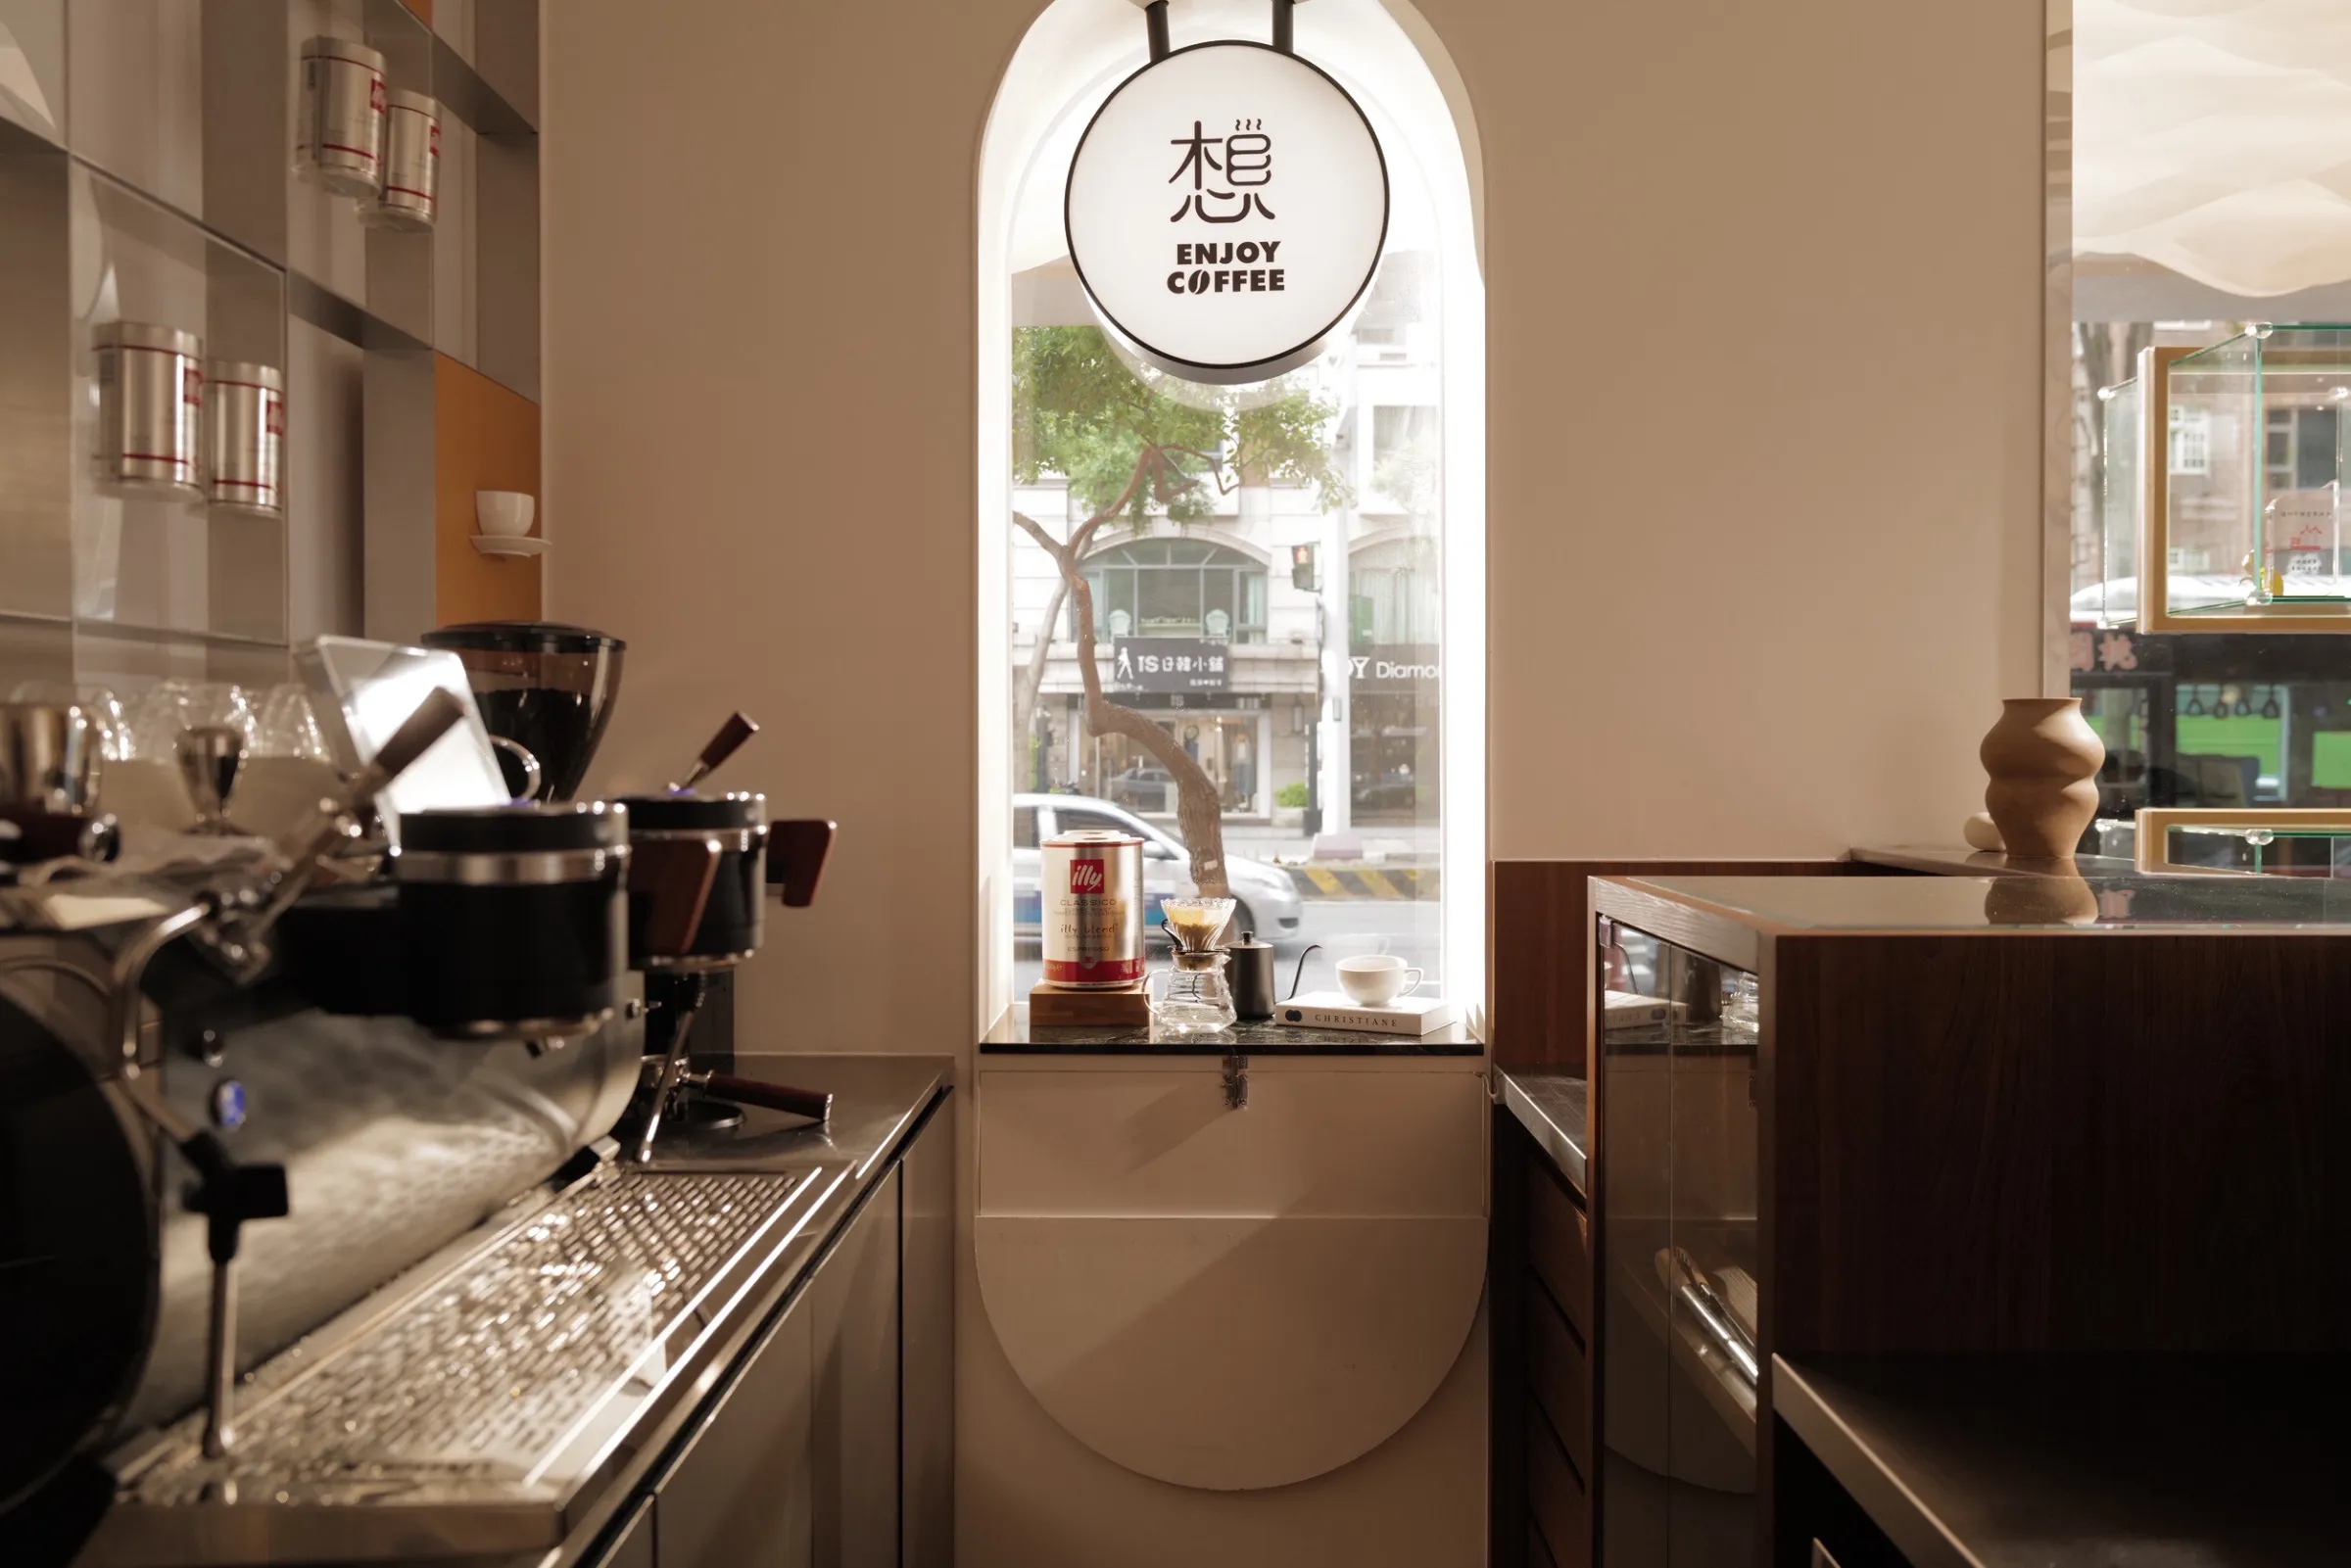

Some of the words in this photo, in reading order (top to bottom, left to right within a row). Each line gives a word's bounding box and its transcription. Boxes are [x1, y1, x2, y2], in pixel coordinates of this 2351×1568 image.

[1168, 119, 1276, 223] 想
[1176, 241, 1280, 265] ENJOY
[1167, 268, 1284, 295] COFFEE
[1137, 655, 1159, 673] IS
[1375, 661, 1439, 679] Diamo
[1072, 864, 1102, 891] illy
[1061, 924, 1078, 934] illy
[1315, 1014, 1398, 1027] CHRISTIANE
